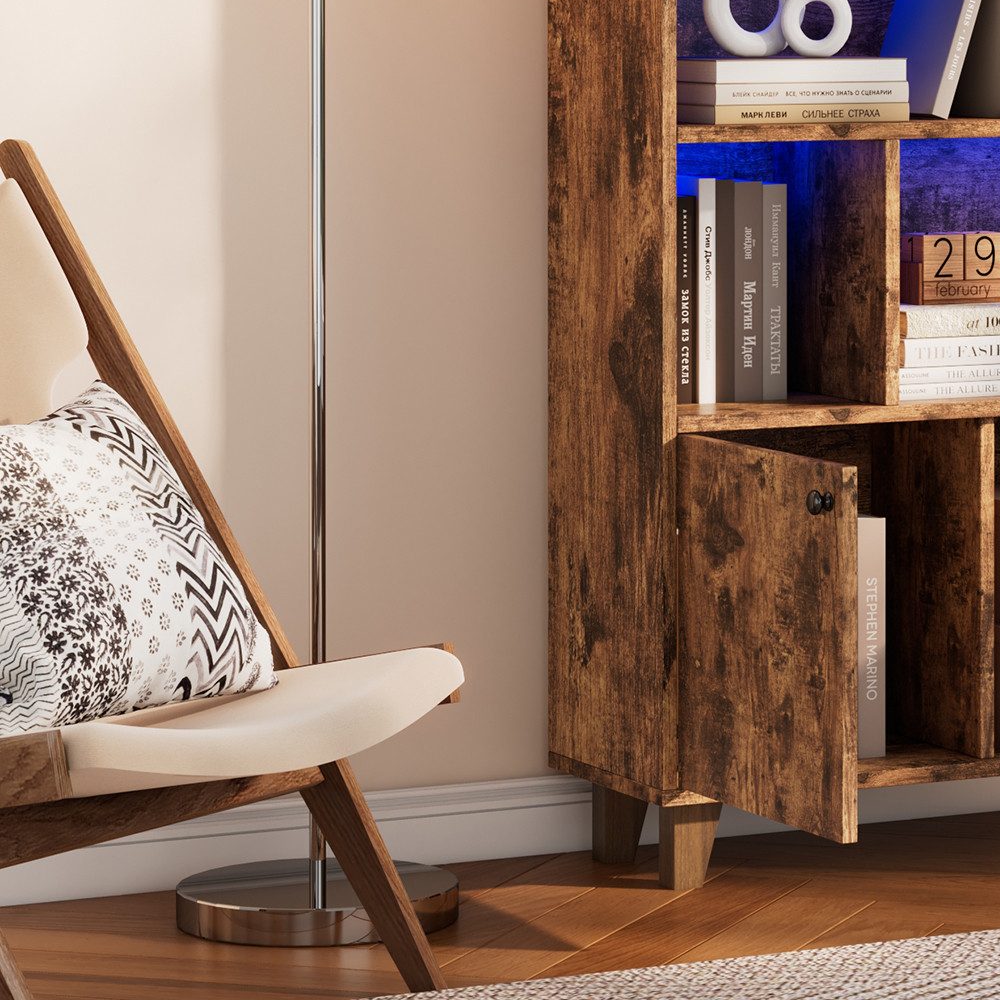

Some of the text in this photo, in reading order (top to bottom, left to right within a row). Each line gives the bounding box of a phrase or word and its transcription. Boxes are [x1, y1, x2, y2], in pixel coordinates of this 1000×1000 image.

[955, 36, 965, 51] LES
[948, 53, 960, 81] JOURS
[799, 90, 811, 98] ЧТО
[811, 90, 834, 98] НУЖНО
[836, 89, 853, 97] ЗНАТЬ
[861, 89, 892, 98] СЦЕНАРИИ
[764, 111, 787, 119] ЛЕВИ
[801, 109, 843, 119] СИЛЬНЕЕ
[847, 108, 880, 118] СТРАХА
[704, 250, 712, 281] Джобс
[770, 204, 782, 375] Иммануил Кант ТРАКТАТЫ
[935, 281, 991, 298] february
[740, 281, 756, 330] Мартин
[966, 318, 980, 330] at
[741, 335, 756, 368] Иден
[914, 346, 952, 360] THE
[946, 370, 964, 379] THE
[936, 386, 952, 395] THE
[959, 384, 998, 394] ALLURE
[866, 577, 878, 701] STEPHEN MARINO
